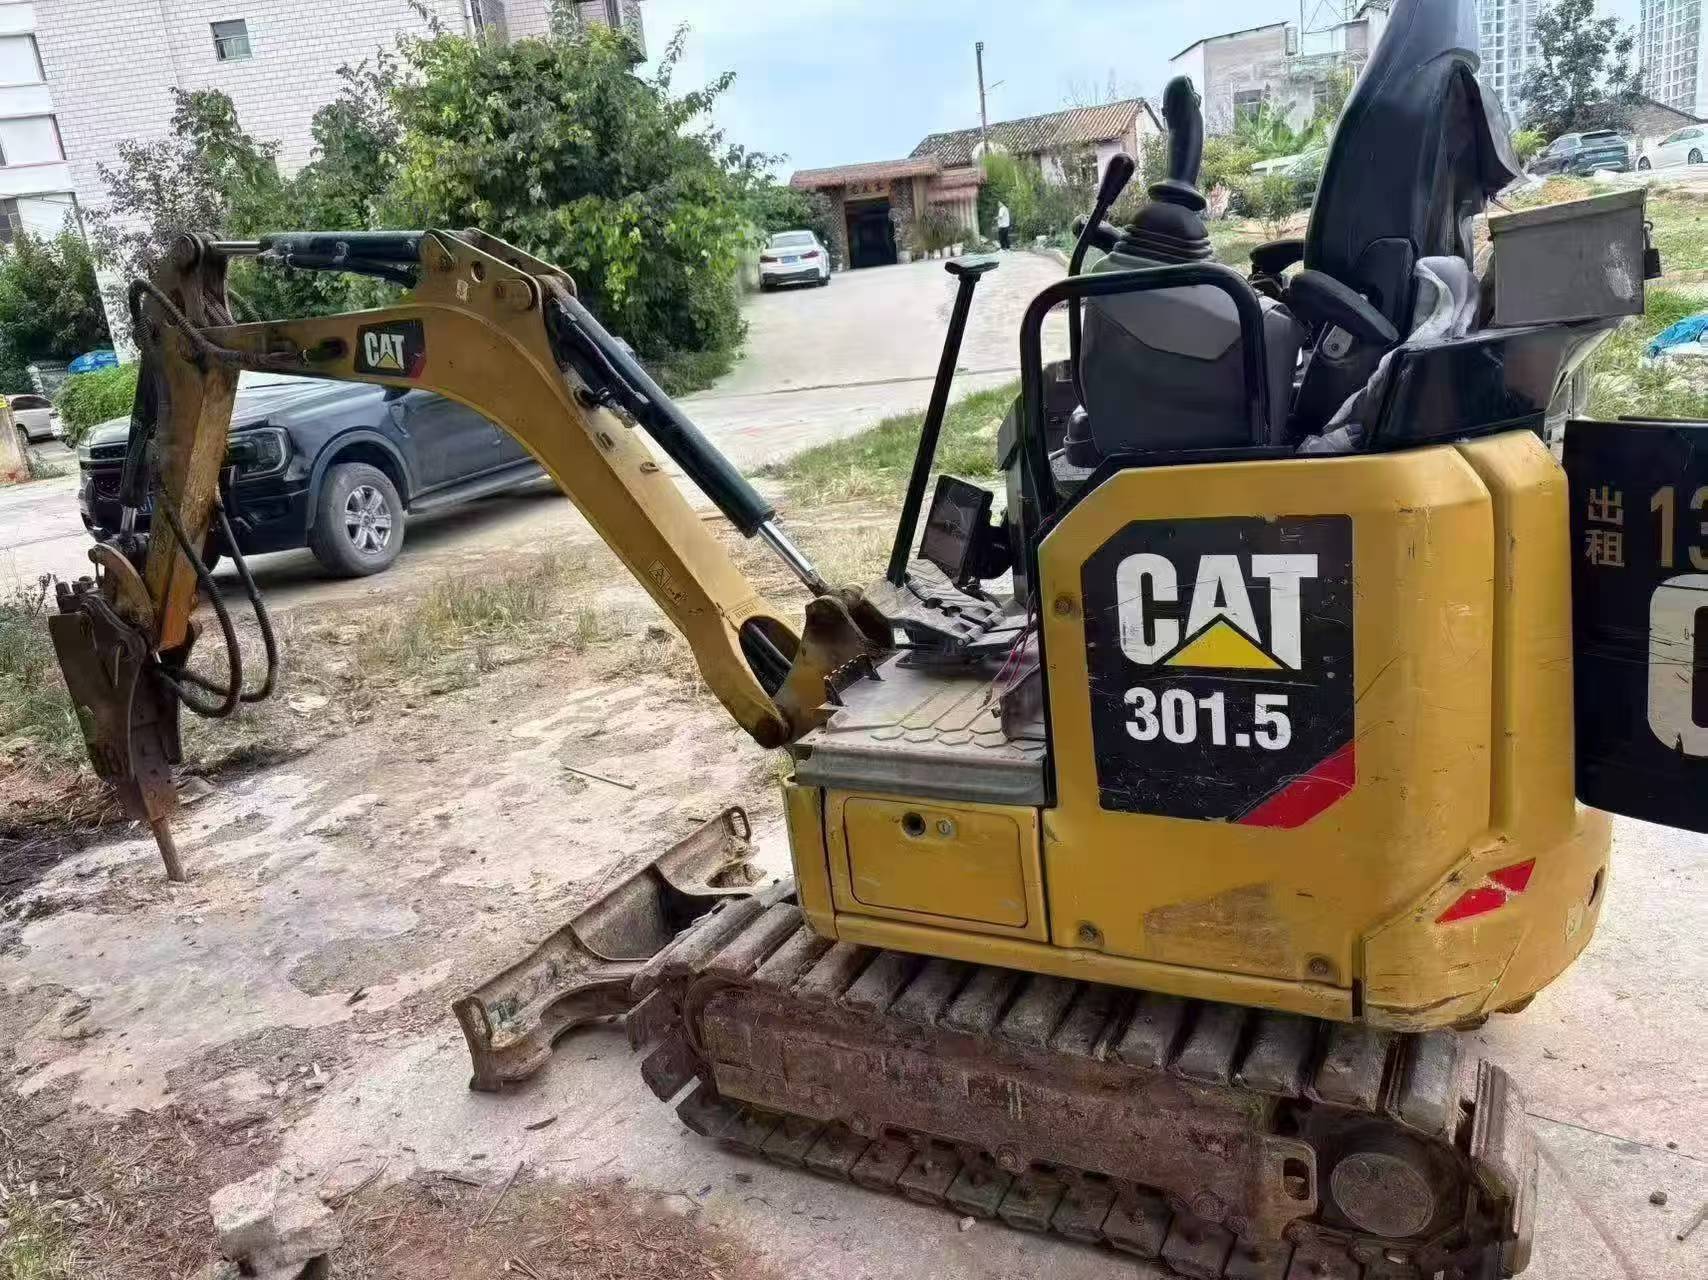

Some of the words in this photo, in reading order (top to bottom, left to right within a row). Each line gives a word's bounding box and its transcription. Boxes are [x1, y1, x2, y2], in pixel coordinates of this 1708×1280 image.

[364, 331, 405, 371] CAT
[1584, 485, 1625, 568] 出租
[1116, 552, 1319, 670] CAT
[1123, 686, 1293, 751] 301.5
